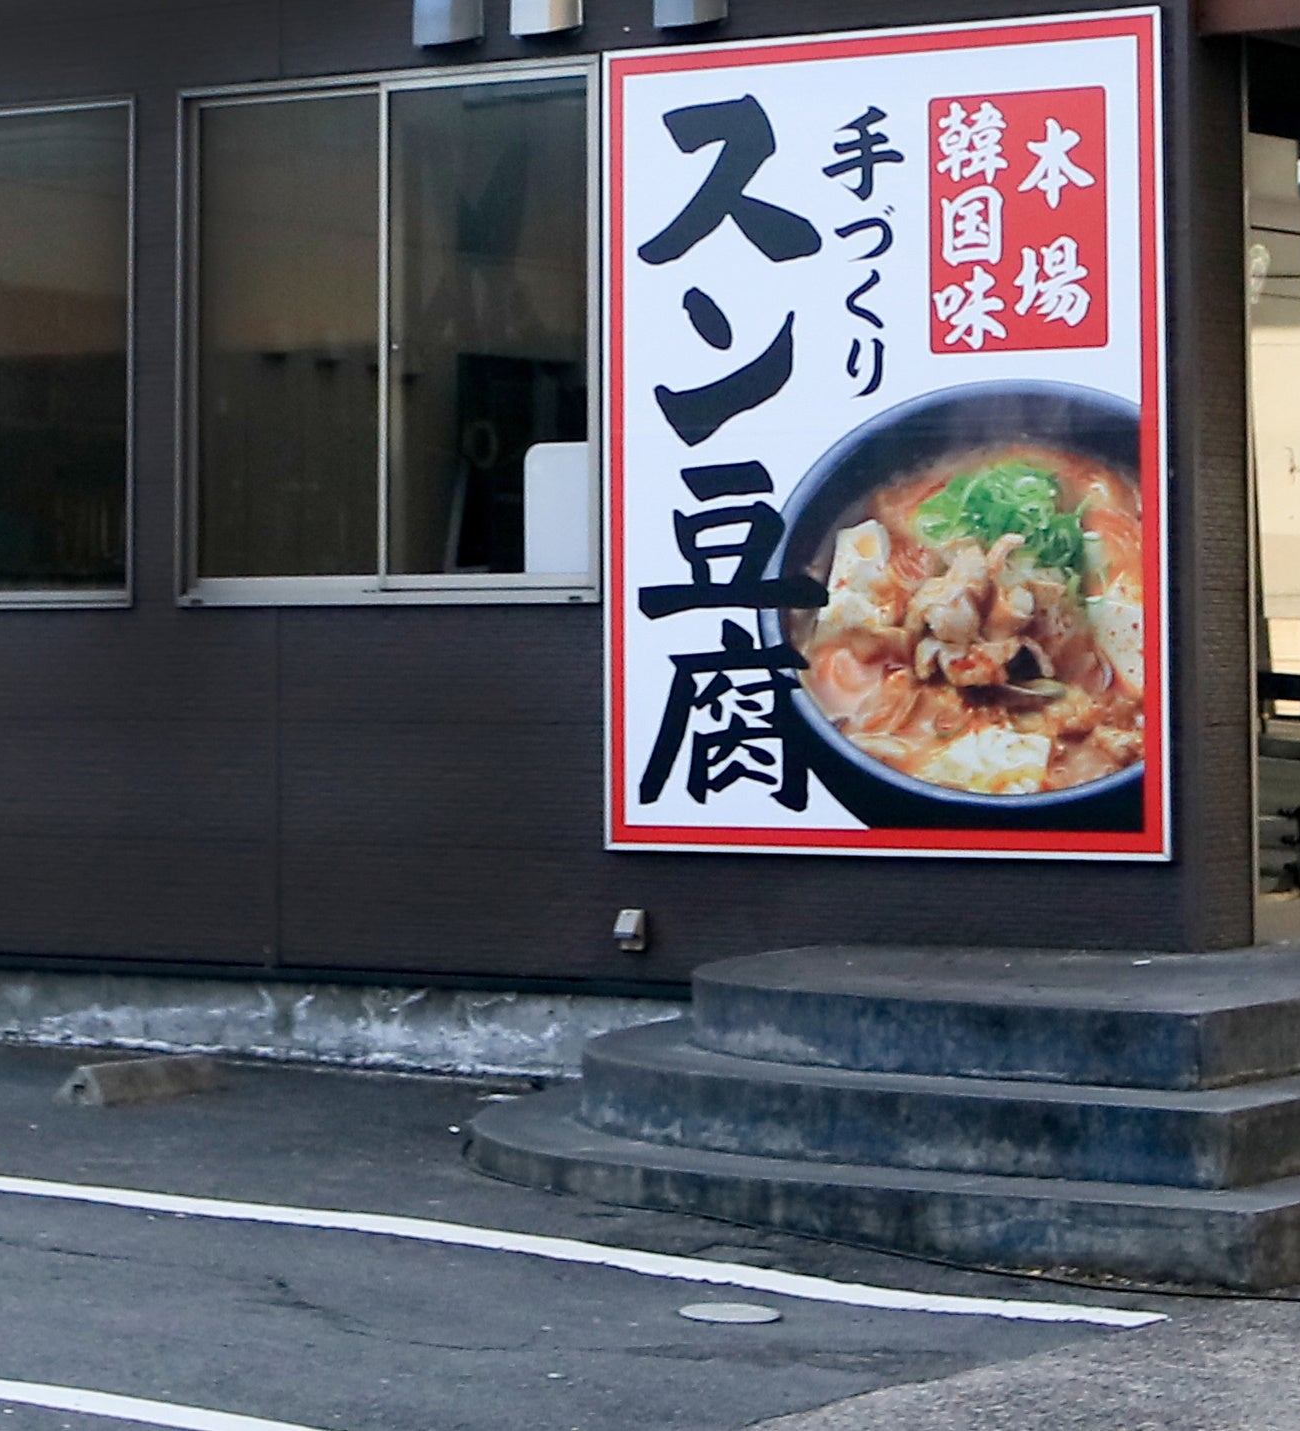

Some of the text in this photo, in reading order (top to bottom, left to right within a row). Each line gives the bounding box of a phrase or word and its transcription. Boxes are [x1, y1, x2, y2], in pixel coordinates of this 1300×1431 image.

[822, 105, 904, 399] 手づくり
[934, 100, 1007, 351] 韓国味
[1016, 119, 1095, 329] 本場
[637, 93, 829, 813] スン豆腐
